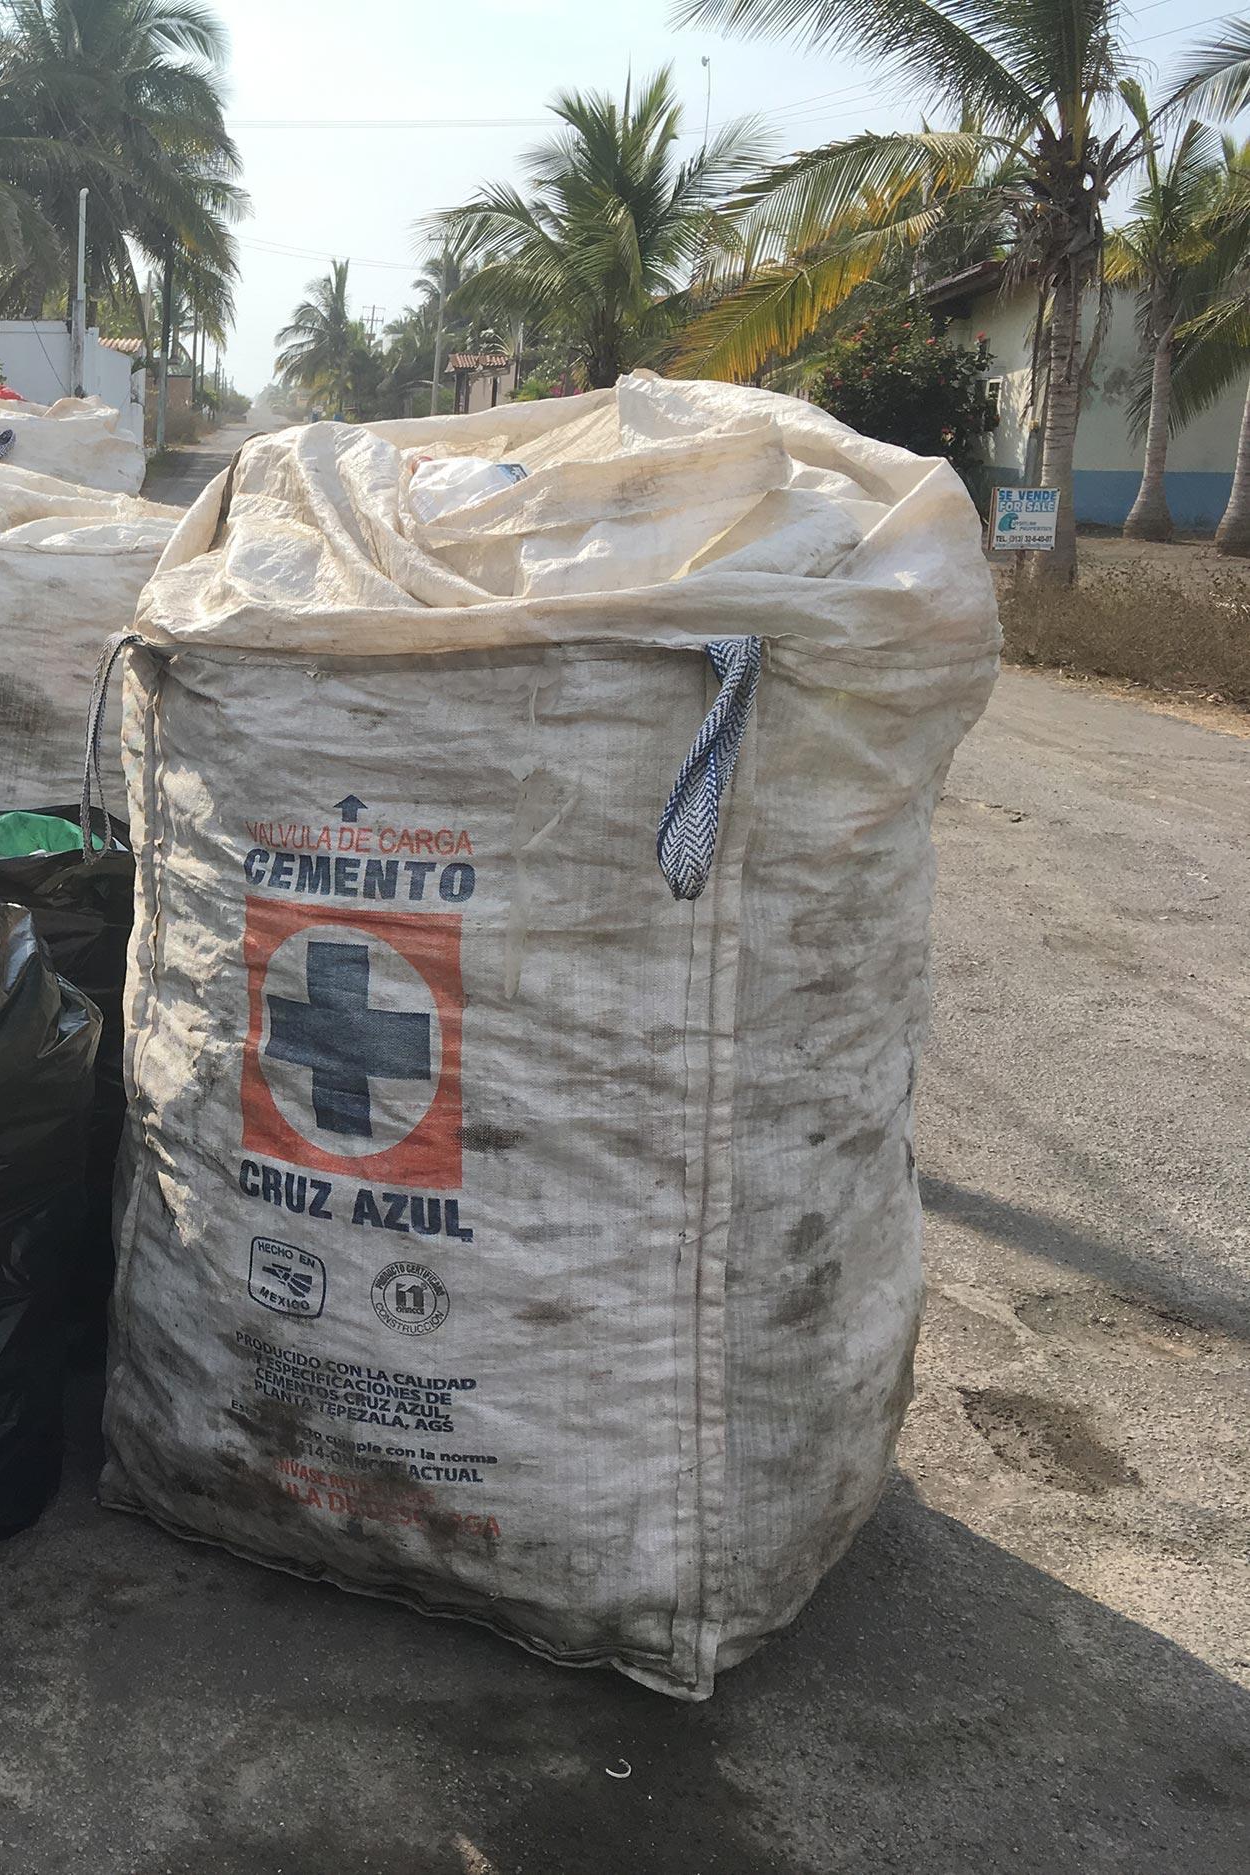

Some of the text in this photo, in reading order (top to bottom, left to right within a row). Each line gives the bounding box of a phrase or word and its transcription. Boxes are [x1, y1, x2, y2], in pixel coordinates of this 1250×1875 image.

[998, 490, 1057, 501] SE VENDE
[998, 500, 1055, 512] FOR SALE
[337, 826, 373, 853] DE
[378, 826, 474, 856] CARGA
[243, 848, 476, 903] CEMENTO
[239, 1159, 474, 1239] CRUZ AZUL
[257, 1241, 316, 1270] HECHO EN
[258, 1286, 311, 1312] MEXICO
[375, 1302, 445, 1333] CONSTRUCCION
[236, 1331, 477, 1391] PRODUCIDO CON LA CALIDAD
[255, 1367, 451, 1420] CEMENTOS CRUZ AZUL,
[267, 1357, 420, 1402] ESPECIFICACIONES
[425, 1391, 452, 1406] DE
[415, 1418, 454, 1433] AGS
[385, 1446, 416, 1459] con
[420, 1448, 436, 1461] la
[440, 1453, 498, 1465] norma
[408, 1464, 484, 1483] ACTUAL
